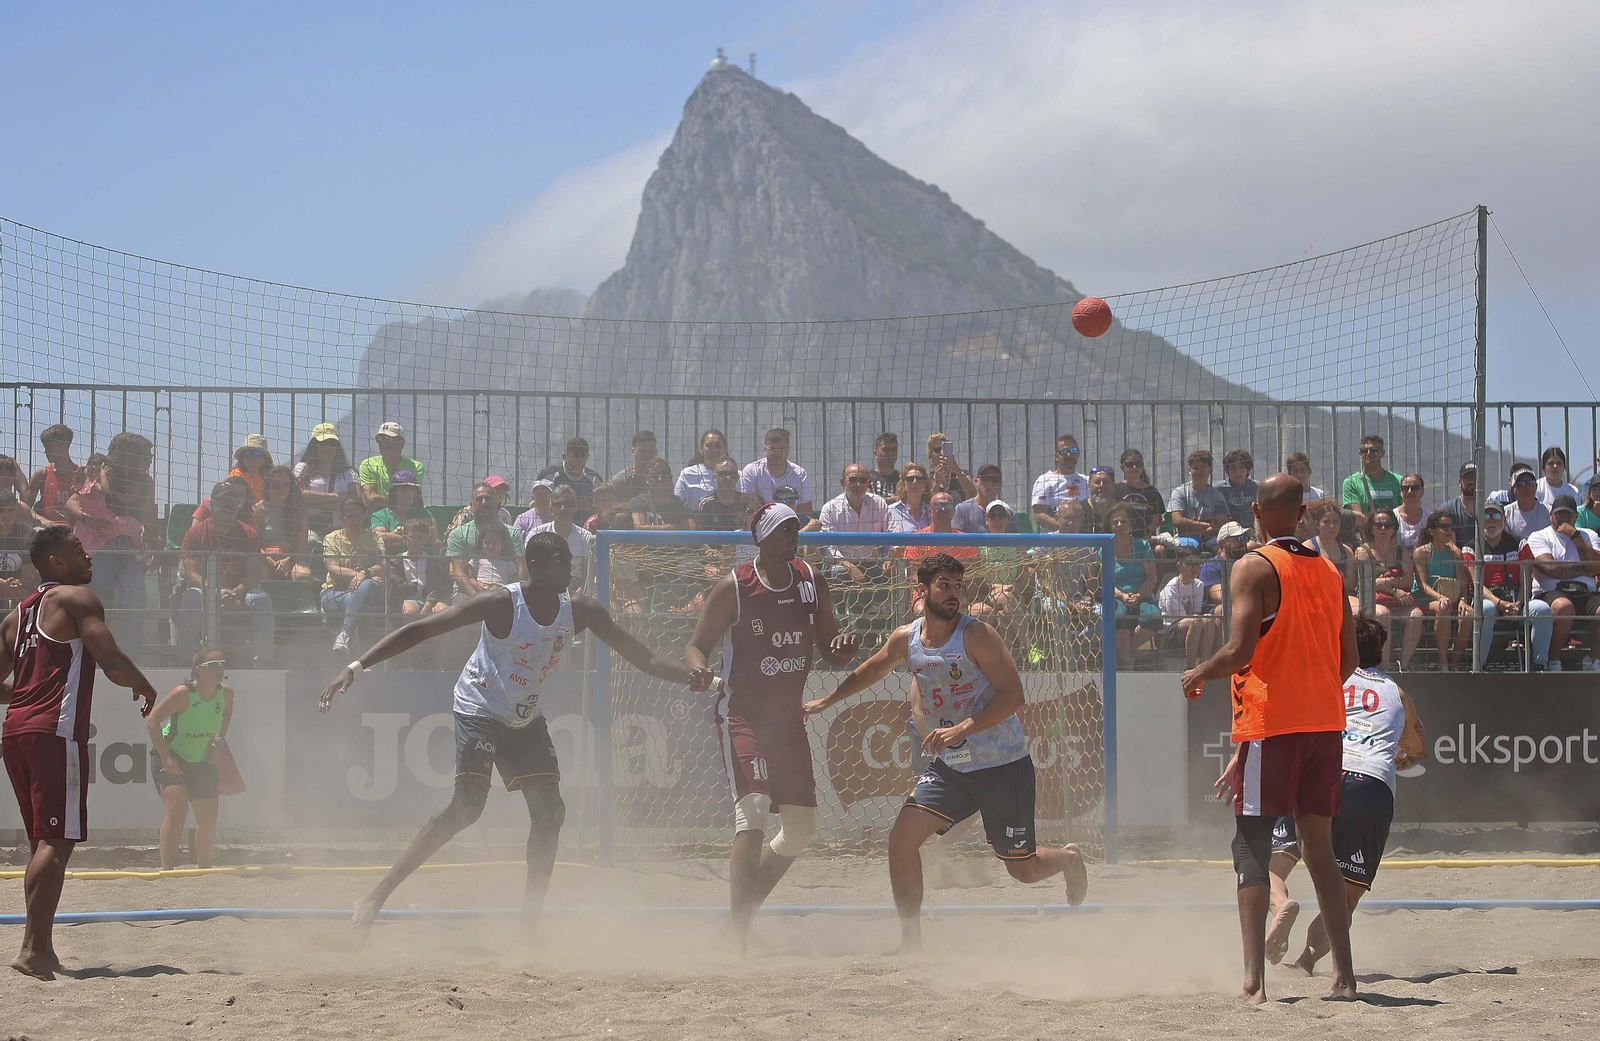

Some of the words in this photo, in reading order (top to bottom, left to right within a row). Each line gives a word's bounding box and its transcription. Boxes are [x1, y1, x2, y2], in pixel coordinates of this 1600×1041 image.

[797, 580, 815, 603] 10
[771, 630, 803, 648] QAT
[509, 673, 528, 686] AVIS
[932, 688, 944, 708] 5
[1343, 684, 1380, 713] 10
[1433, 723, 1599, 773] elksport
[750, 756, 768, 780] 10
